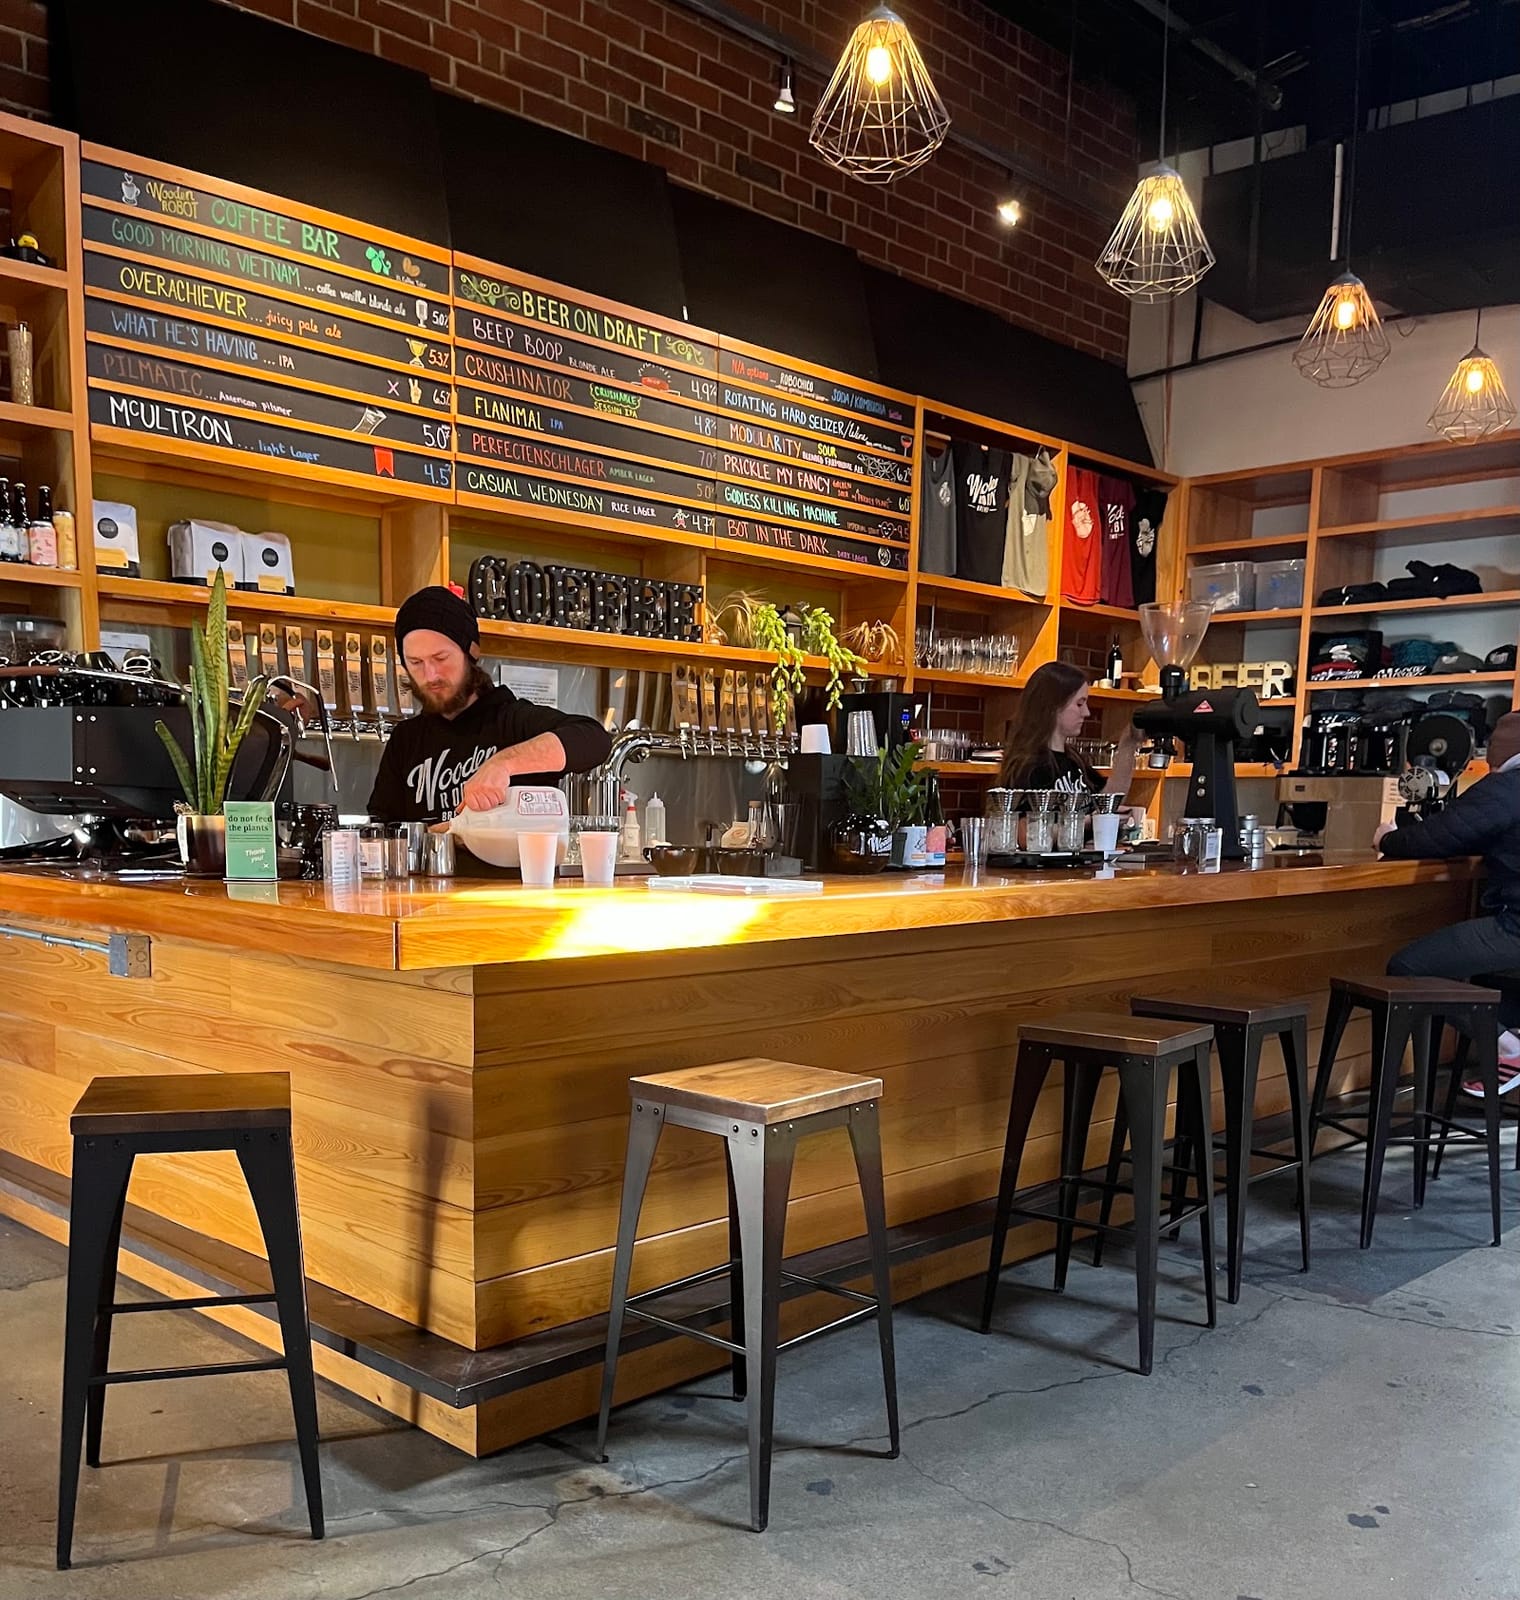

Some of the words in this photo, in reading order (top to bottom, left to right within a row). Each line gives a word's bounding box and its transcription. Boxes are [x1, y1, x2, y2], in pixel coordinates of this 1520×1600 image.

[146, 181, 195, 202] Wooden
[162, 201, 199, 220] ROBOT
[211, 200, 291, 244] COFFEE
[302, 223, 340, 260] BAR
[111, 218, 154, 247] GOOD
[161, 231, 230, 270] MORNING
[236, 252, 301, 288] VIETNAM
[316, 283, 337, 298] coffee
[340, 290, 367, 305] vanilla
[120, 267, 247, 318] OVERACHIEVER
[266, 311, 293, 333] juicy
[298, 320, 319, 336] pale
[325, 324, 343, 339] ale
[111, 311, 159, 338] WHAT
[165, 322, 199, 347] HE'S
[205, 329, 258, 361] HAVING
[278, 354, 295, 371] IPA
[522, 291, 570, 329] BEER
[573, 308, 599, 337] ON
[603, 316, 662, 354] DRAFT
[472, 318, 514, 349] BEEP
[524, 334, 563, 361] BOOP
[568, 356, 597, 374] BLONDE
[600, 367, 616, 378] ALE
[103, 353, 203, 397] PILMATIC
[219, 391, 257, 409] American
[261, 397, 292, 417] pilsner
[465, 355, 573, 401] CRUSHINATOR
[731, 359, 745, 375] N/A
[746, 367, 769, 381] options
[779, 372, 814, 393] ROBOCHICO
[474, 396, 544, 431] FLANIMAL
[550, 418, 564, 431] IPA
[593, 401, 622, 416] SESSION
[625, 409, 638, 419] IPA
[724, 389, 777, 418] ROTATING
[781, 406, 807, 425] HARD
[258, 440, 286, 457] light
[290, 444, 320, 463] Lager
[472, 433, 607, 479] PERFECTENSCHLAGER
[609, 466, 633, 480] AMBER
[635, 472, 656, 483] LAGER
[729, 423, 802, 458] MODULARITY
[817, 442, 837, 459] SOUR
[724, 454, 771, 481] PRICKLE
[776, 467, 793, 485] MY
[797, 471, 831, 494] FANCY
[853, 464, 865, 475] ALE
[467, 471, 522, 497] CASUAL
[527, 483, 603, 512] WEDNESDAY
[611, 501, 630, 514] RICE
[633, 503, 657, 518] LAGER
[762, 495, 799, 517] KILLING
[802, 503, 841, 526] MACHINE
[727, 519, 749, 539] BOT
[755, 524, 769, 543] IN
[770, 527, 796, 548] THE
[799, 533, 829, 555] DARK
[851, 553, 868, 563] LAGER
[468, 555, 703, 643] COFFEE
[407, 745, 497, 811] Wooden
[228, 815, 239, 823] do
[255, 815, 273, 823] feed
[243, 824, 269, 833] plants
[245, 847, 266, 857] Thank
